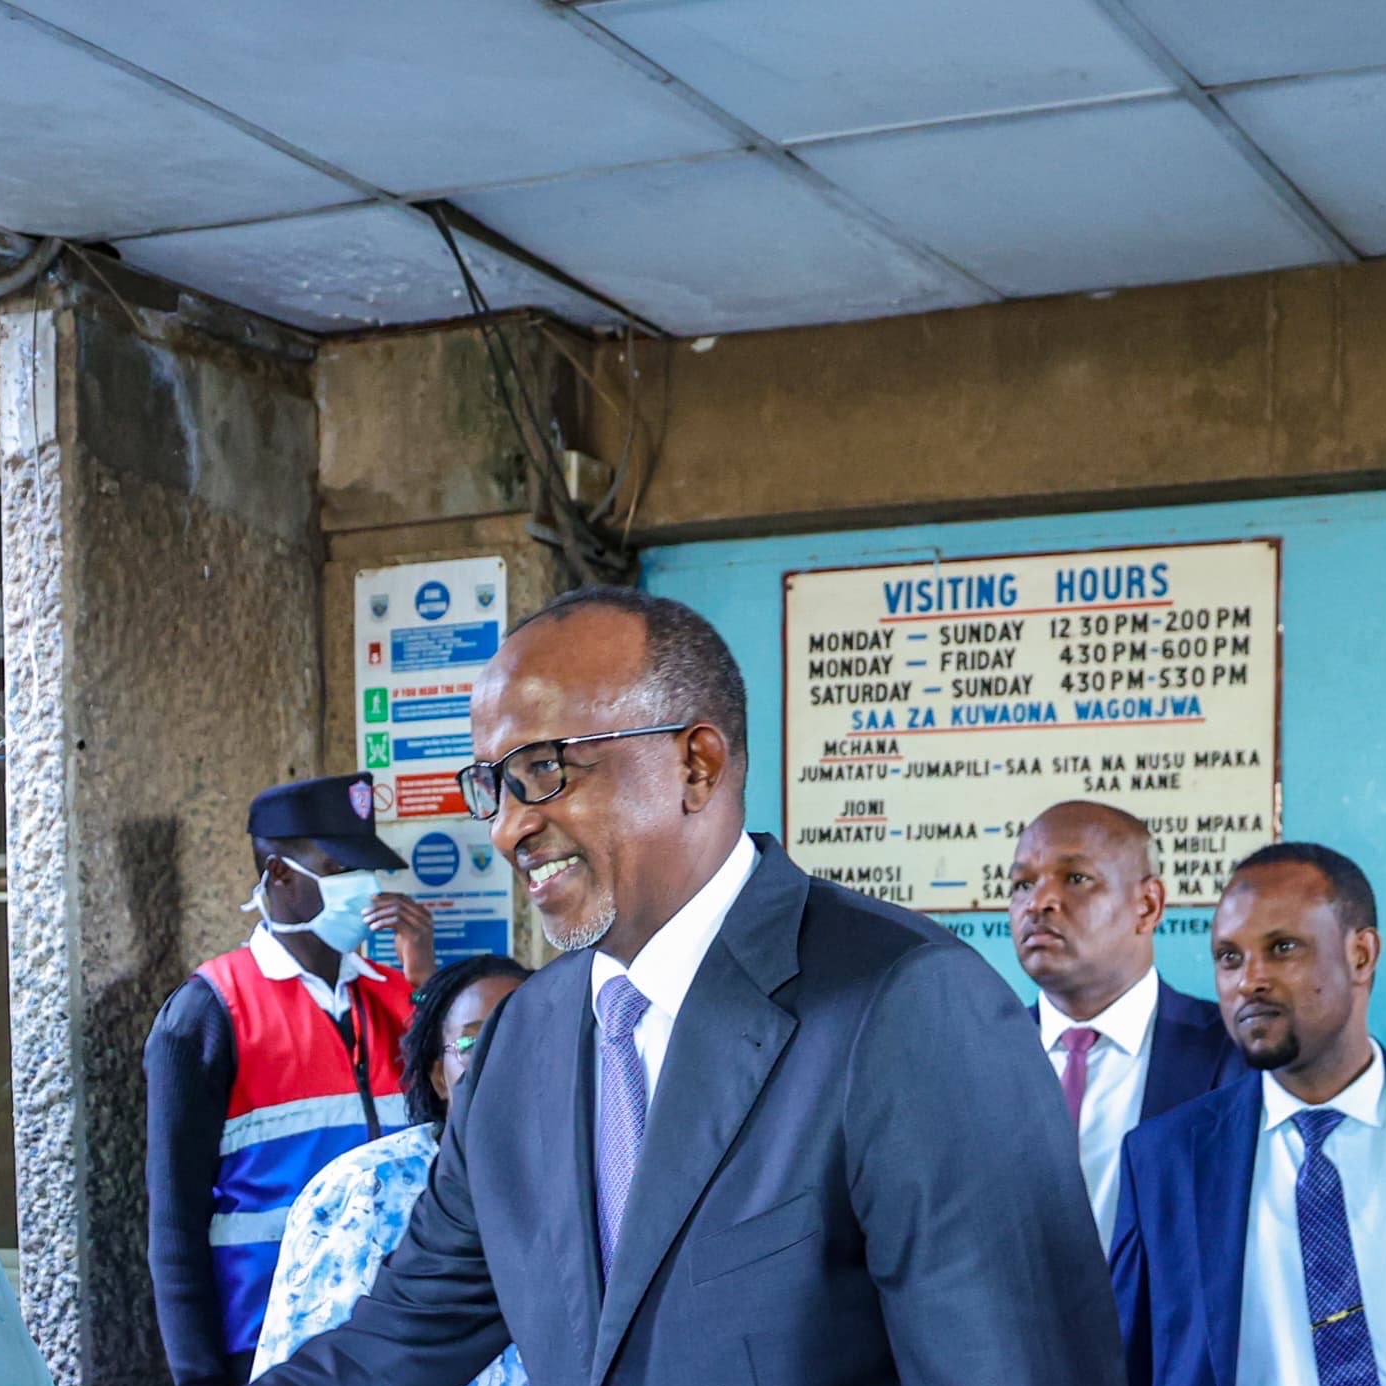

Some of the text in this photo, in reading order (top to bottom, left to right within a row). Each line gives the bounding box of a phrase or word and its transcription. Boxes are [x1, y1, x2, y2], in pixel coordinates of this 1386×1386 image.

[884, 562, 1168, 614] VISITING HOURS
[809, 628, 894, 654] MONDAY
[940, 620, 1025, 646] SUNDAY
[1217, 606, 1251, 628] PM
[809, 655, 893, 680] MONDAY
[941, 649, 1016, 672] FRIDAY
[1214, 635, 1250, 657] PM
[810, 681, 912, 706] SATURDAY
[952, 674, 1033, 698] SUNDAY
[1213, 664, 1248, 686] PM
[852, 695, 1202, 730] SAA ZA KUWAONA WAGONJWA
[823, 739, 899, 756] MCHANA
[1053, 756, 1091, 773] SITA
[1102, 756, 1126, 771] NA
[1136, 753, 1185, 770] NUSU
[1194, 750, 1260, 768] MPAKA
[1084, 773, 1181, 792] SAA NANE
[841, 800, 884, 816] JIONI
[1198, 814, 1263, 832] MPAKA
[1175, 838, 1226, 853] MBILI
[1179, 880, 1202, 895] NA
